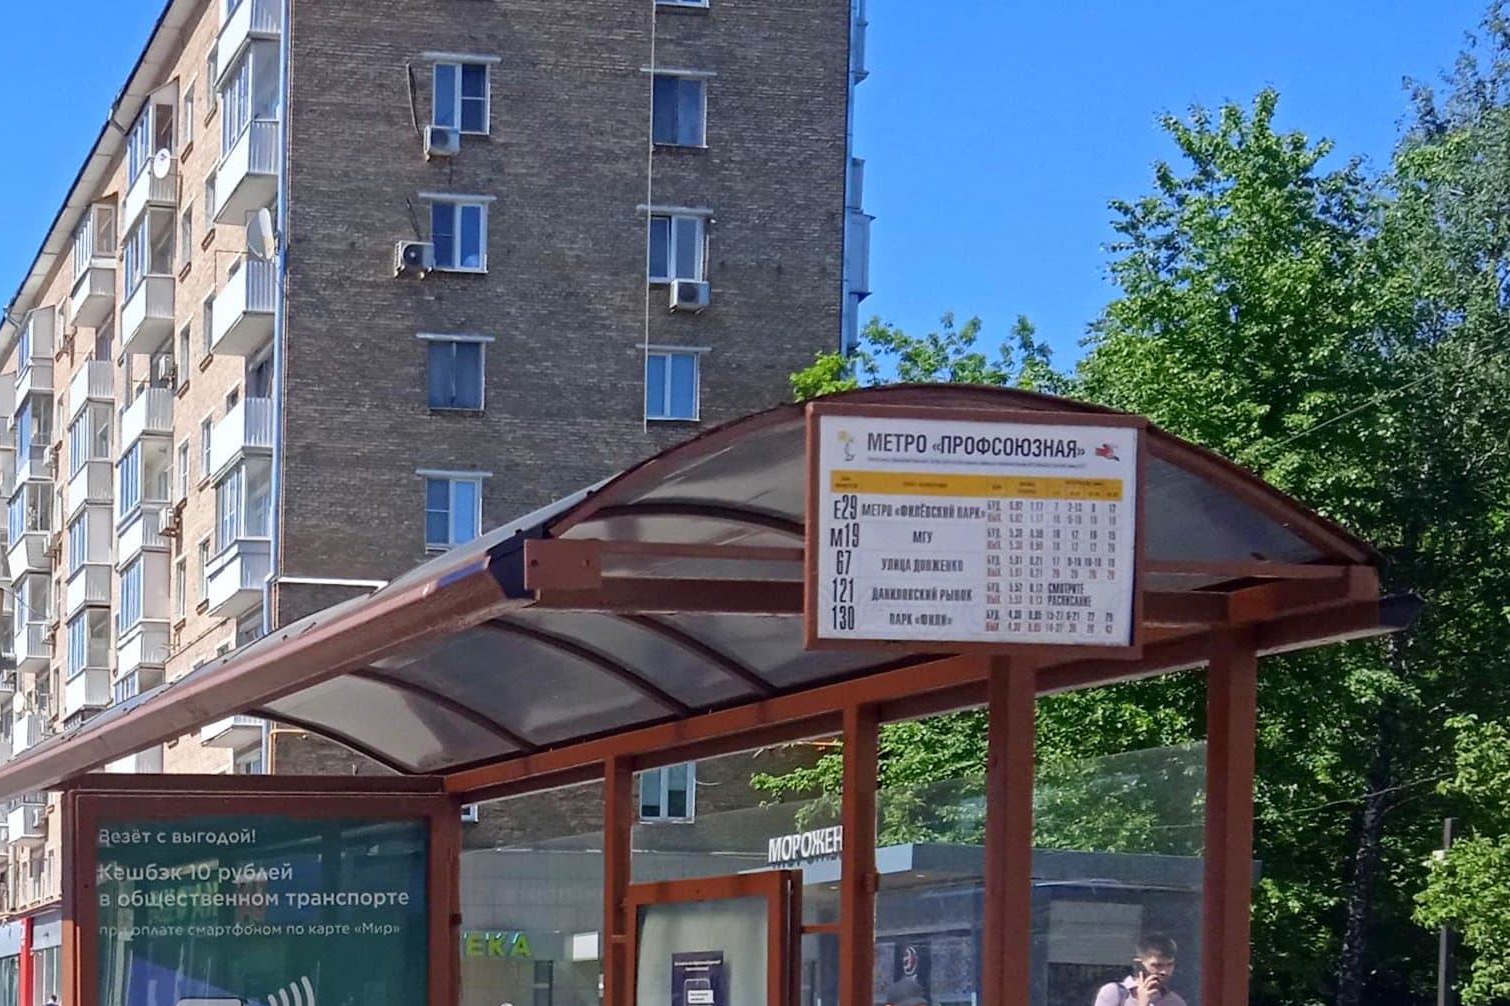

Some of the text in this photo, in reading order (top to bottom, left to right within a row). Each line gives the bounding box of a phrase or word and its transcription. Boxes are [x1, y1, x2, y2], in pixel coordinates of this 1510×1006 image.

[867, 432, 1086, 459] МЕТРО «ПРОФСОЮЗНАЯ»
[862, 504, 893, 517] МЕТРО
[830, 522, 860, 548] М19
[913, 531, 933, 544] МГУ
[836, 550, 852, 575] 67
[881, 558, 911, 572] УЛИЦА
[832, 577, 854, 603] 121
[832, 605, 855, 630] 130
[890, 613, 913, 625] ПАРК
[157, 832, 167, 844] с
[172, 828, 256, 848] выгодой!
[768, 825, 843, 863] МОРОЖЕН
[98, 862, 293, 887] Кешбэк 10 рублей
[99, 888, 410, 911] в общественном транспорте
[99, 921, 401, 938] пр оплате смартфоном по карте «Мир»
